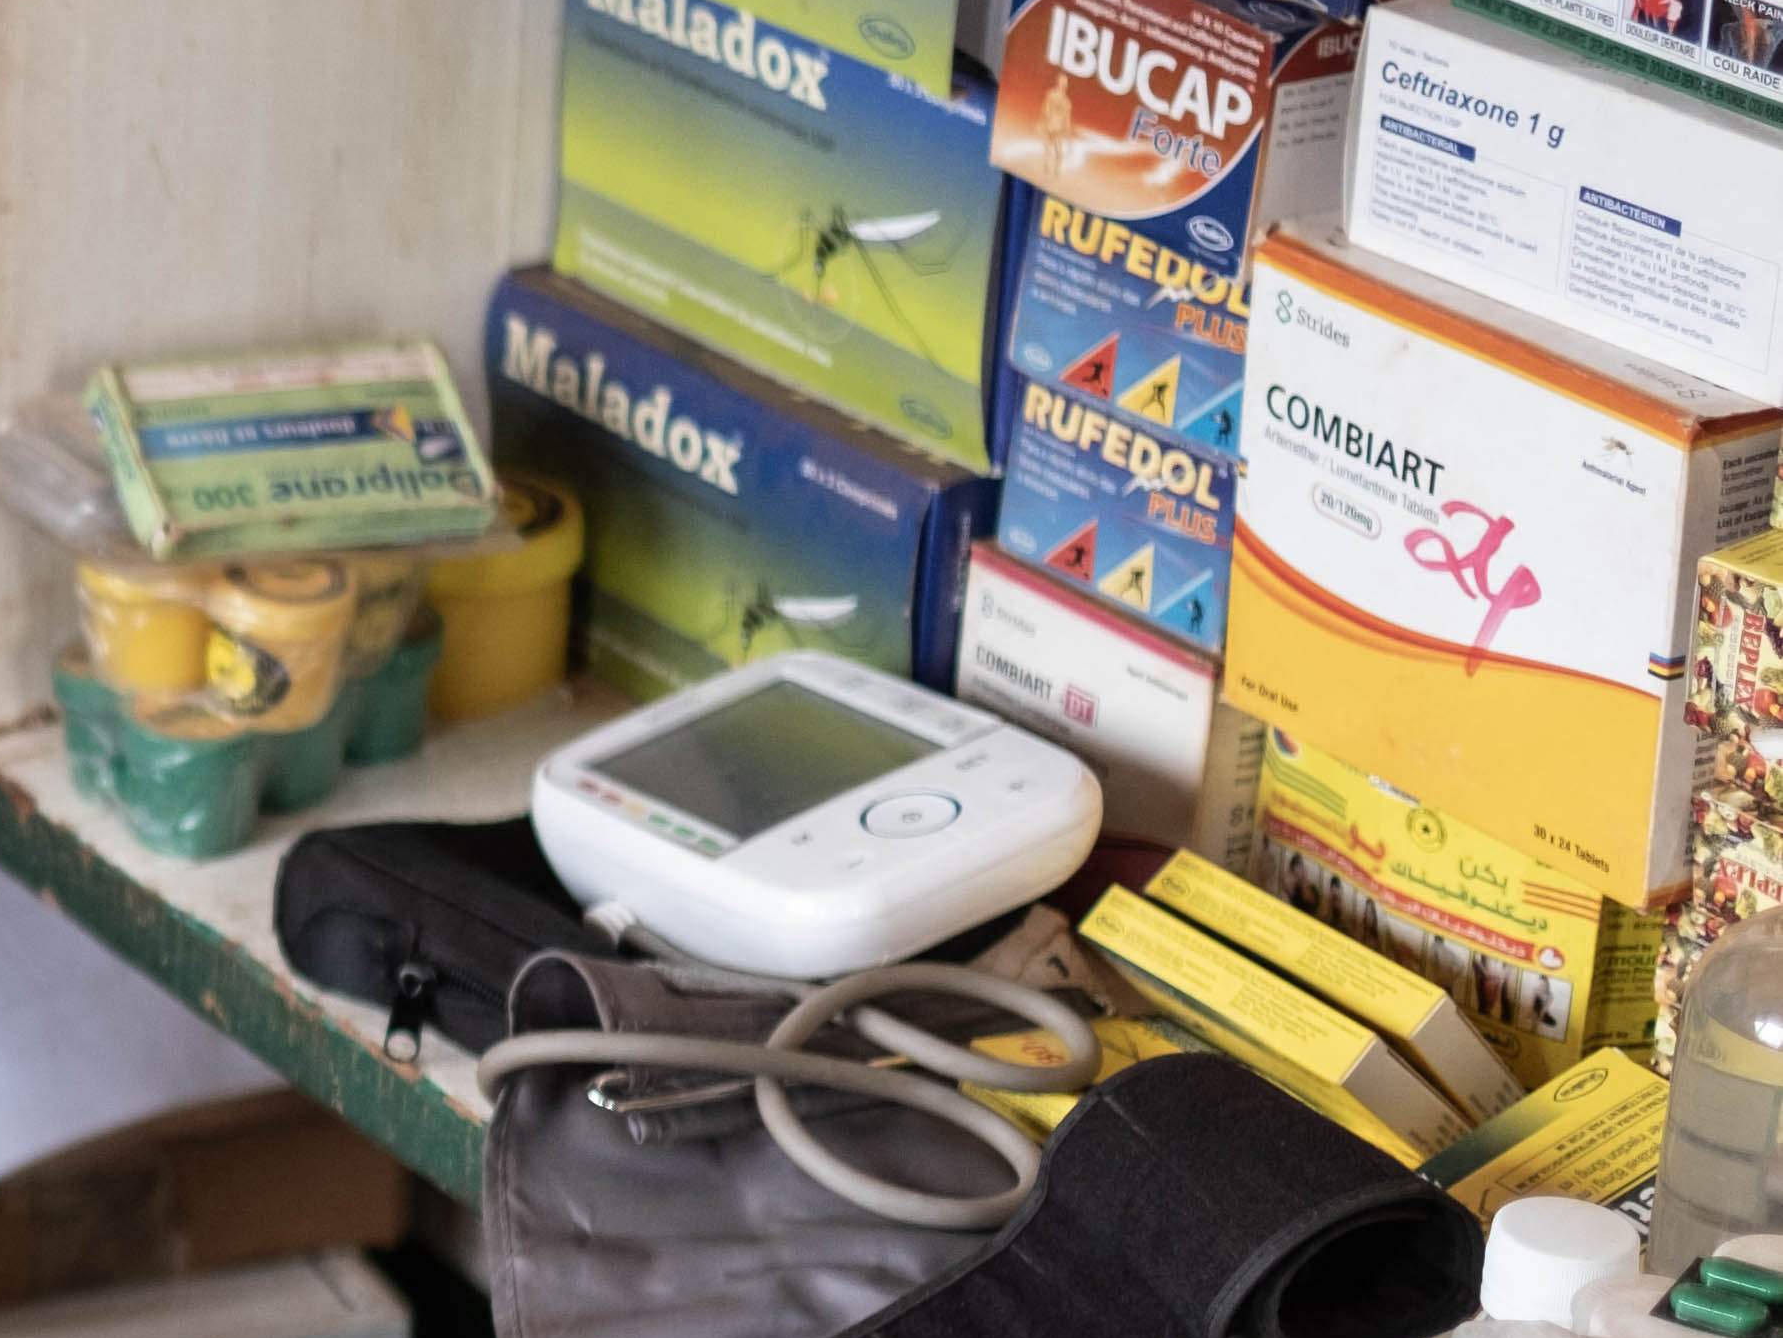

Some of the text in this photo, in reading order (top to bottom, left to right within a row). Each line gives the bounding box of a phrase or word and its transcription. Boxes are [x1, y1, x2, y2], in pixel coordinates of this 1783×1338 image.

[1597, 8, 1615, 29] PIED
[1625, 23, 1696, 60] DOULEUR DENTAIRE
[1757, 2, 1783, 22] PAIN
[1046, 4, 1254, 141] IBUCAP
[1713, 56, 1781, 90] COU RAIDE
[1381, 61, 1565, 149] Ceftriaxone 1 g
[1129, 105, 1221, 177] Forte
[1383, 118, 1460, 155] ANTIBACTERIAL
[1040, 198, 1251, 319] RUFEDOL
[1175, 302, 1248, 355] PLUS
[1296, 304, 1351, 350] Strides
[503, 311, 744, 496] Maladox
[1022, 383, 1221, 512] RUFEDOL
[1266, 383, 1446, 497] COMBIART
[1263, 426, 1321, 467] Artemether
[1401, 492, 1441, 527] Tablets
[1147, 491, 1218, 545] PLUS
[975, 644, 1053, 704] COMBIART
[1736, 608, 1767, 713] BEPLEX
[1557, 837, 1572, 854] 24
[1573, 843, 1611, 874] Tablets
